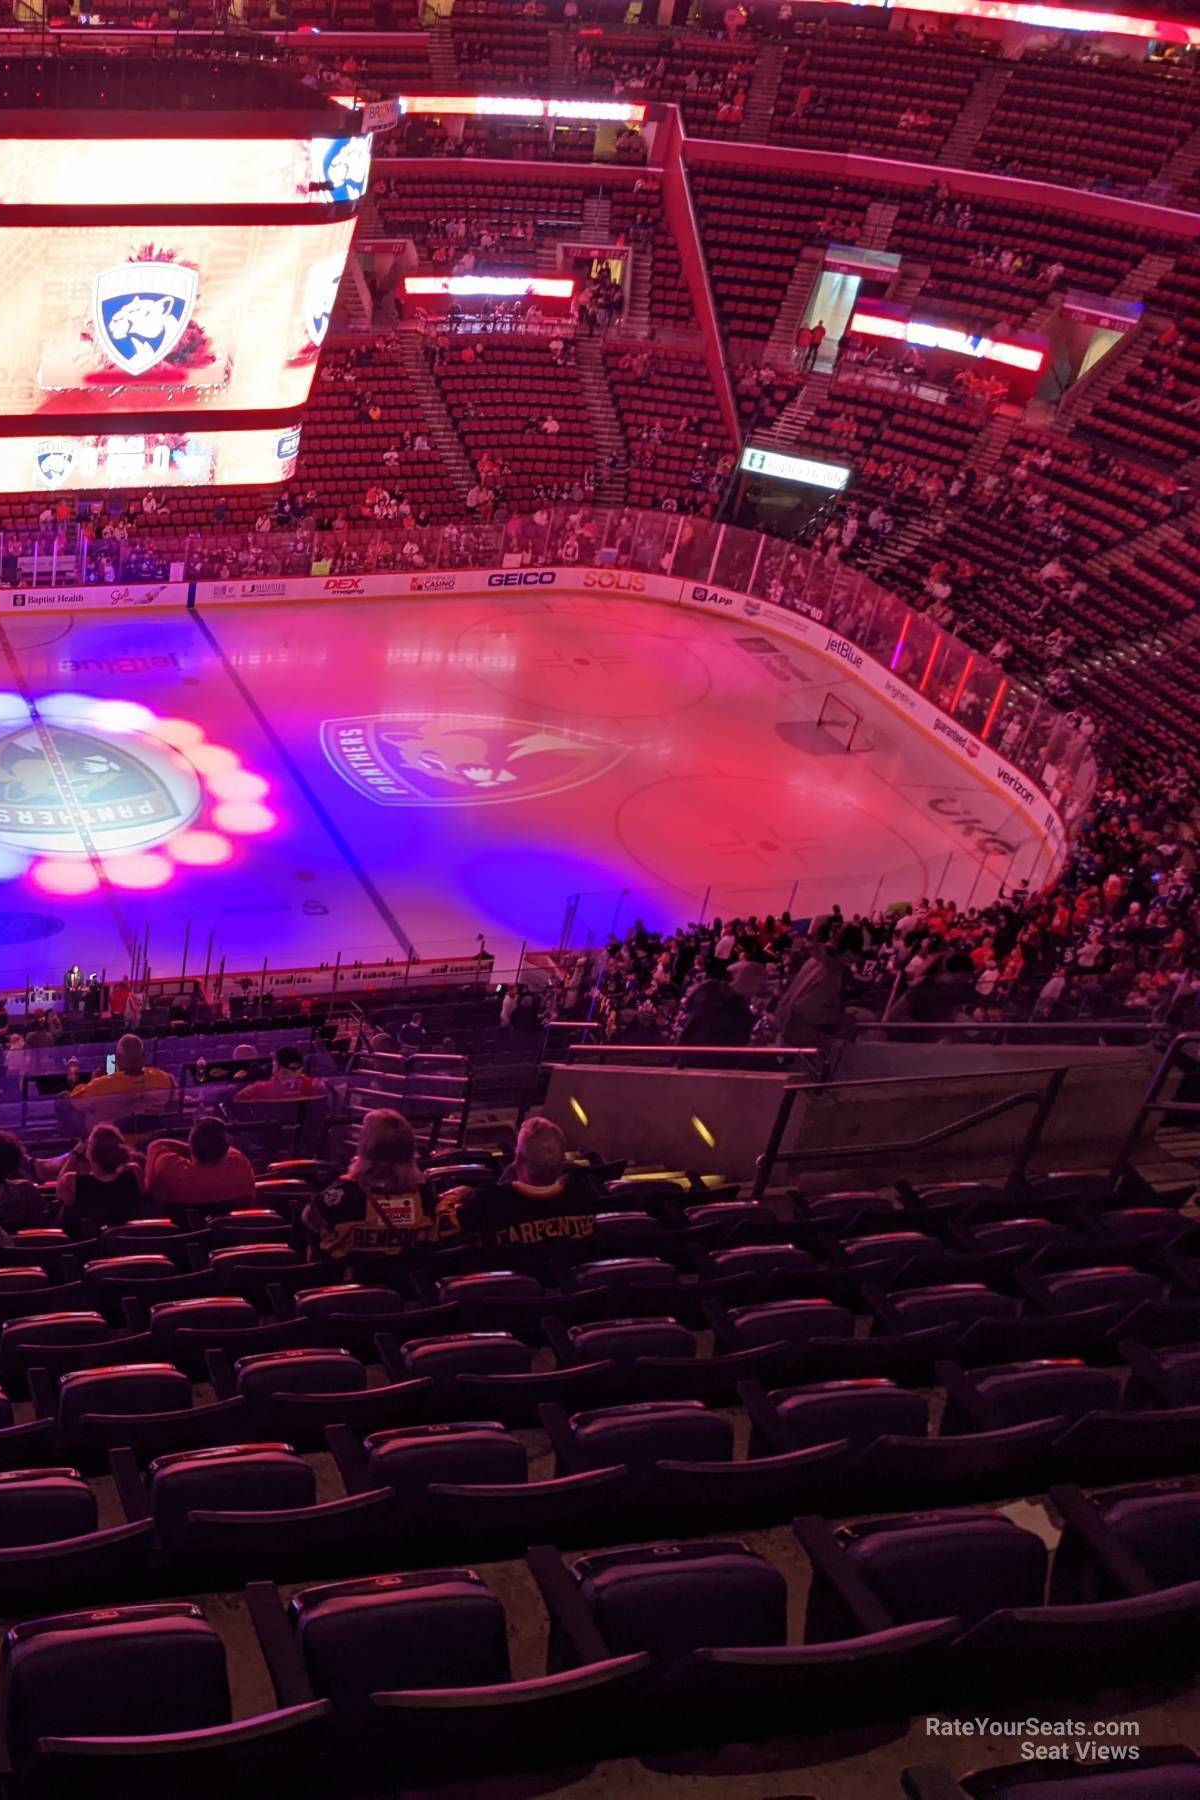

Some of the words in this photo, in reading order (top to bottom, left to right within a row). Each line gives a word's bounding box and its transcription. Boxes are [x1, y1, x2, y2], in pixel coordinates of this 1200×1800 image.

[324, 578, 363, 590] DEX
[487, 571, 556, 587] GEICO
[583, 570, 646, 592] SOLIS
[28, 594, 55, 606] Baptist
[57, 593, 84, 603] Health
[824, 634, 864, 669] jetBlue
[338, 728, 408, 794] PANTHERS
[996, 766, 1035, 806] verizon
